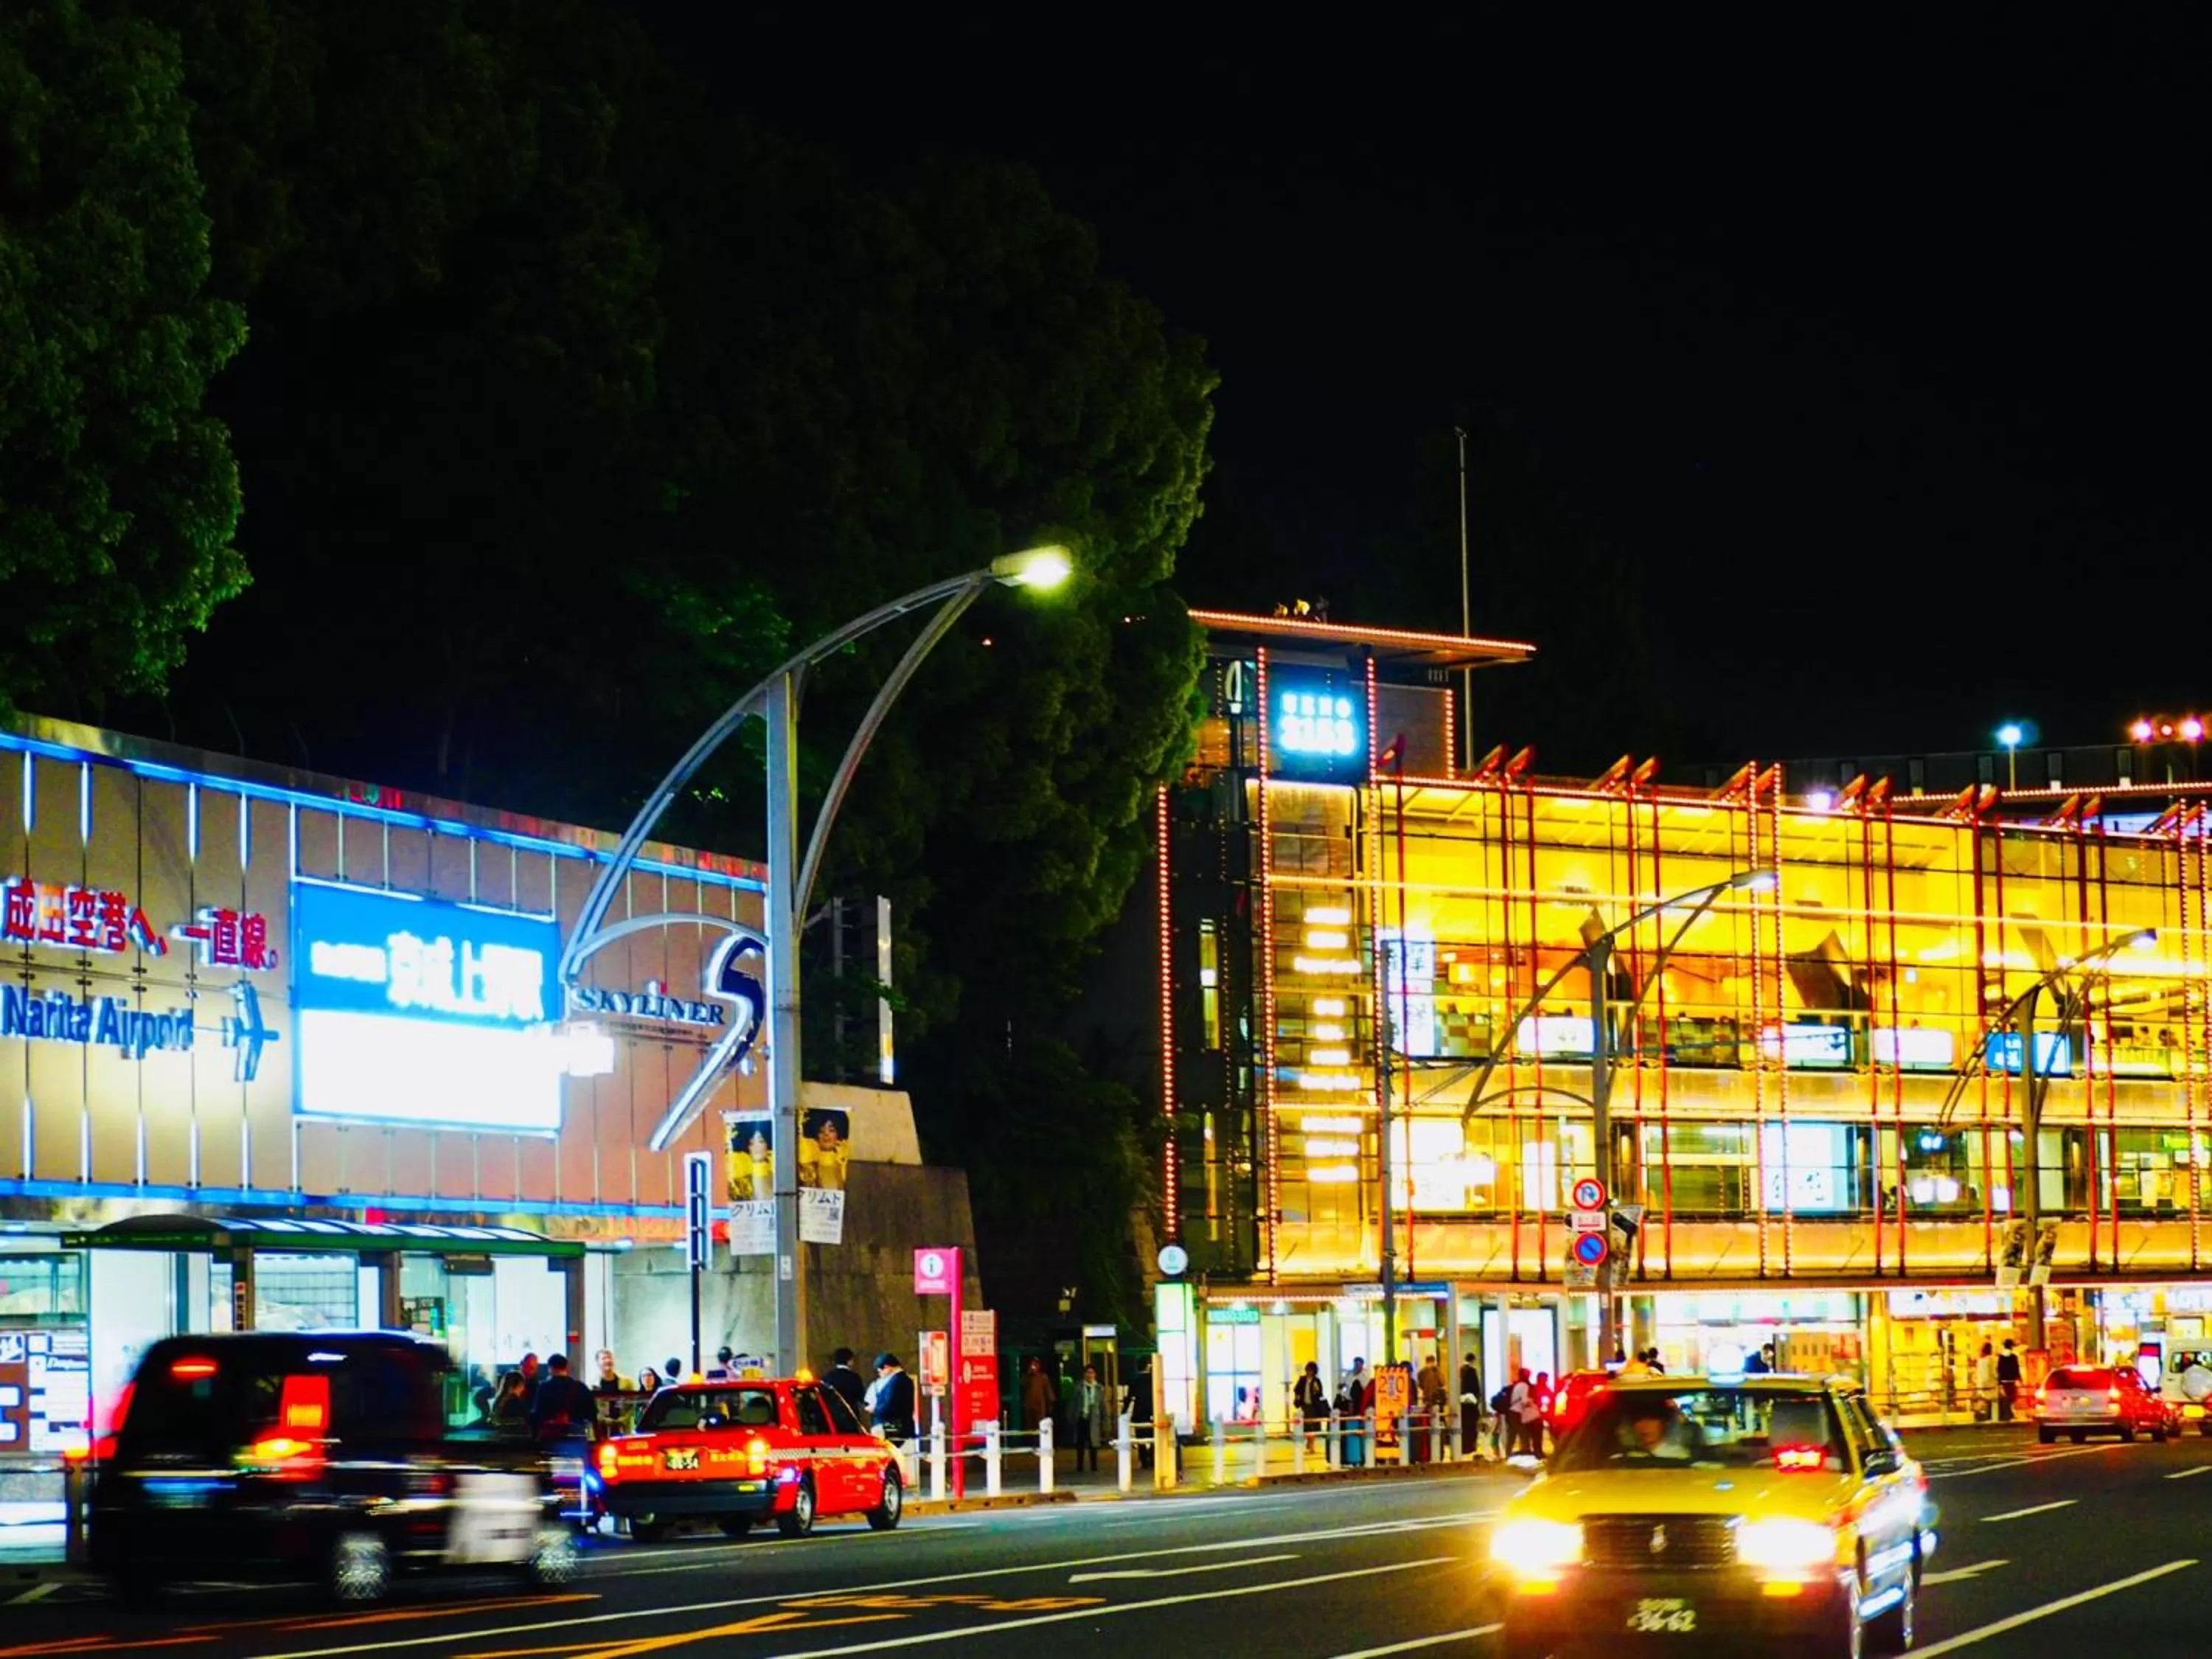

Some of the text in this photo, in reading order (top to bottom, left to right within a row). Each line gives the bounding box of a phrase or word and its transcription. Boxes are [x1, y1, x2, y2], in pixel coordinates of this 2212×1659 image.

[1, 984, 195, 1060] Narita Airport
[574, 986, 726, 1026] SKYLINER
